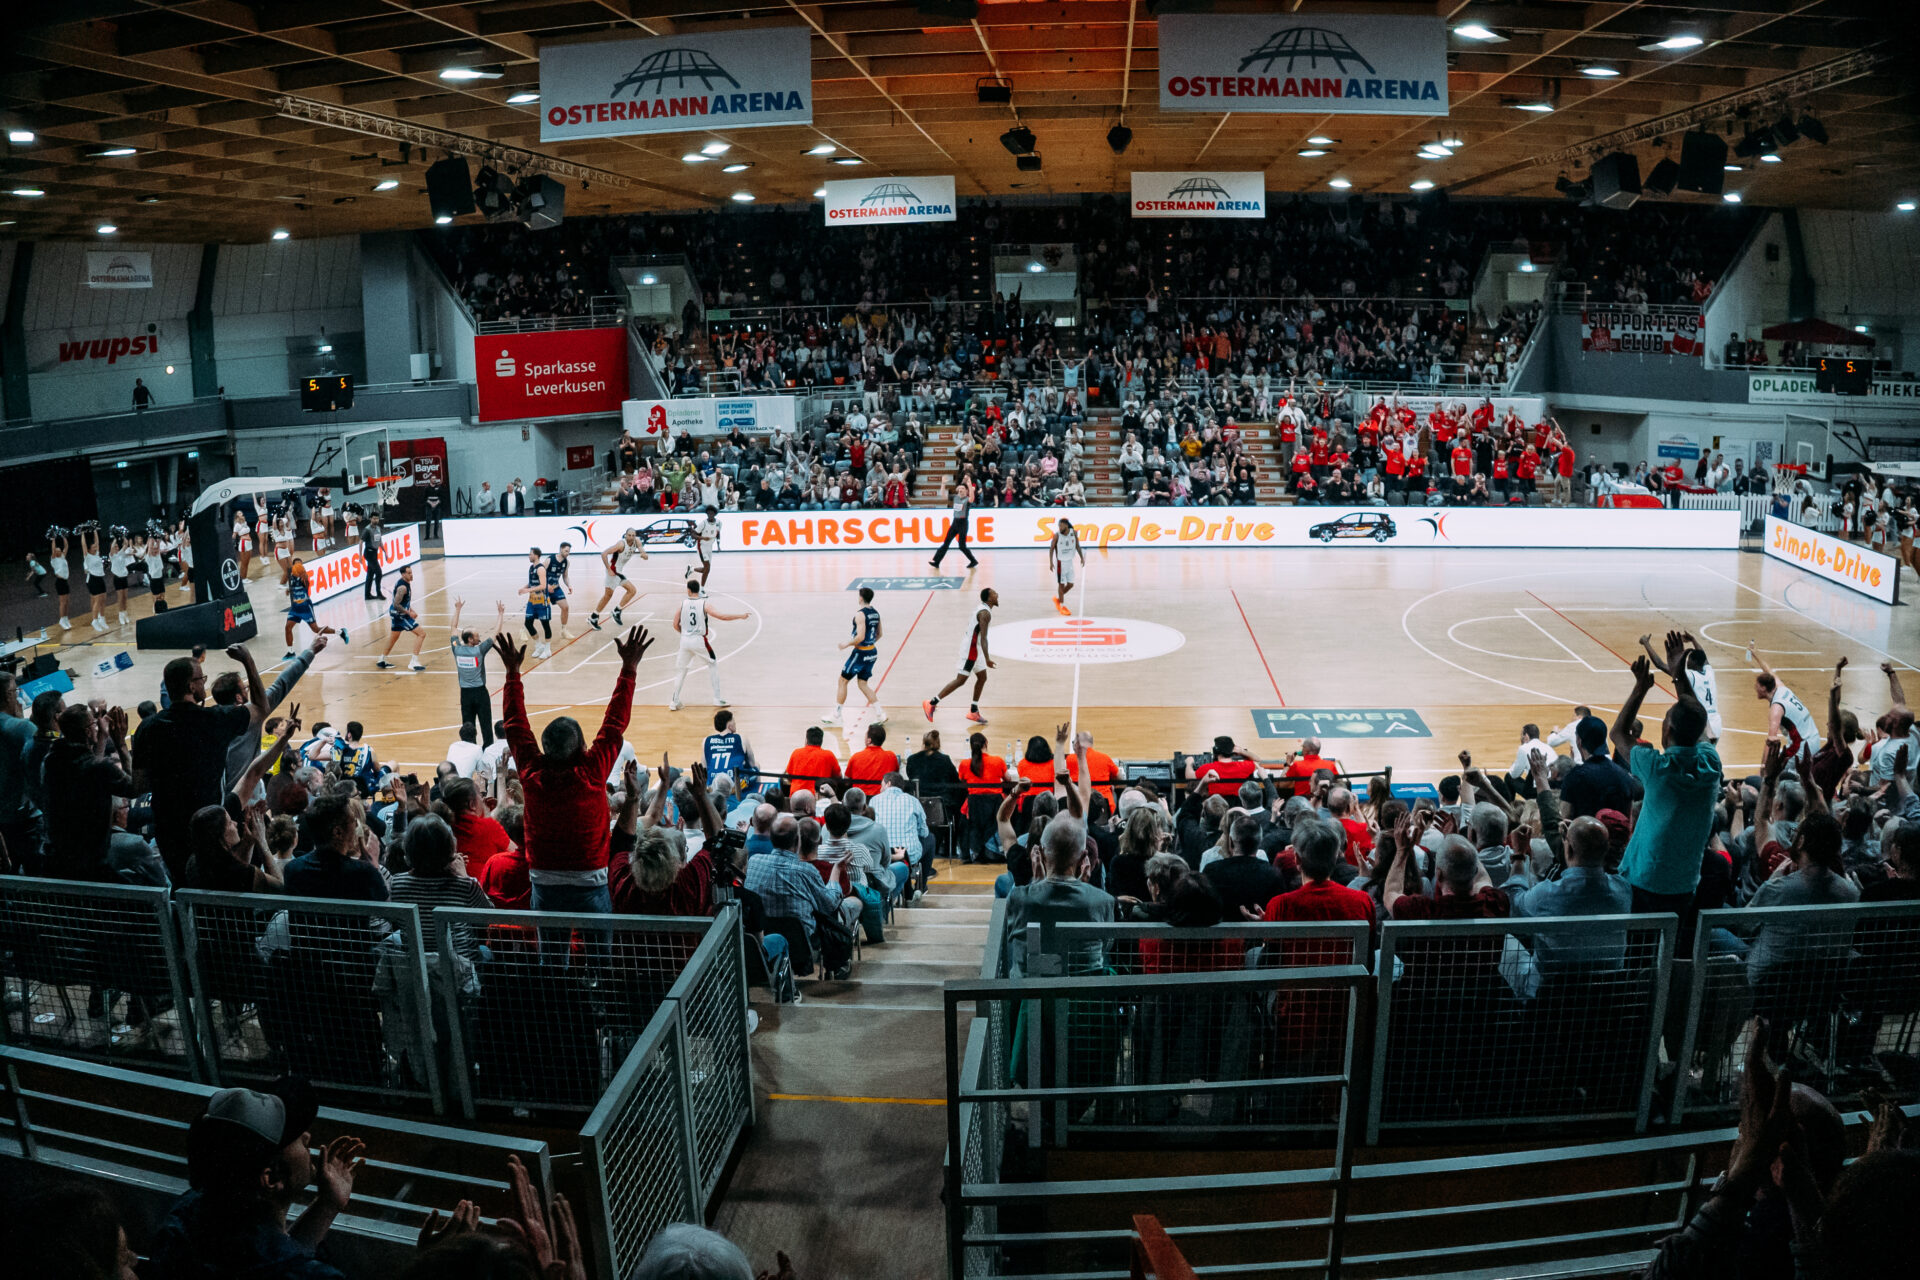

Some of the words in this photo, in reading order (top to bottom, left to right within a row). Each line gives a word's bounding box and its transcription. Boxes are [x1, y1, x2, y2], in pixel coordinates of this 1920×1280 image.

[1588, 313, 1699, 334] SUPPORTERS
[58, 323, 159, 364] wupsi
[1621, 332, 1664, 352] CLUB
[524, 360, 596, 379] Sparkasse
[525, 380, 606, 397] Leverkusen
[672, 418, 704, 426] Apotheke
[415, 464, 440, 473] Bayer
[742, 516, 995, 546] FAHRSCHUE
[1034, 515, 1275, 547] Smple-Drive
[1773, 525, 1882, 587] Simple-Drive
[689, 612, 697, 626] 3
[1705, 688, 1713, 706] 4
[1267, 712, 1408, 721] BARMER
[711, 752, 732, 770] 77
